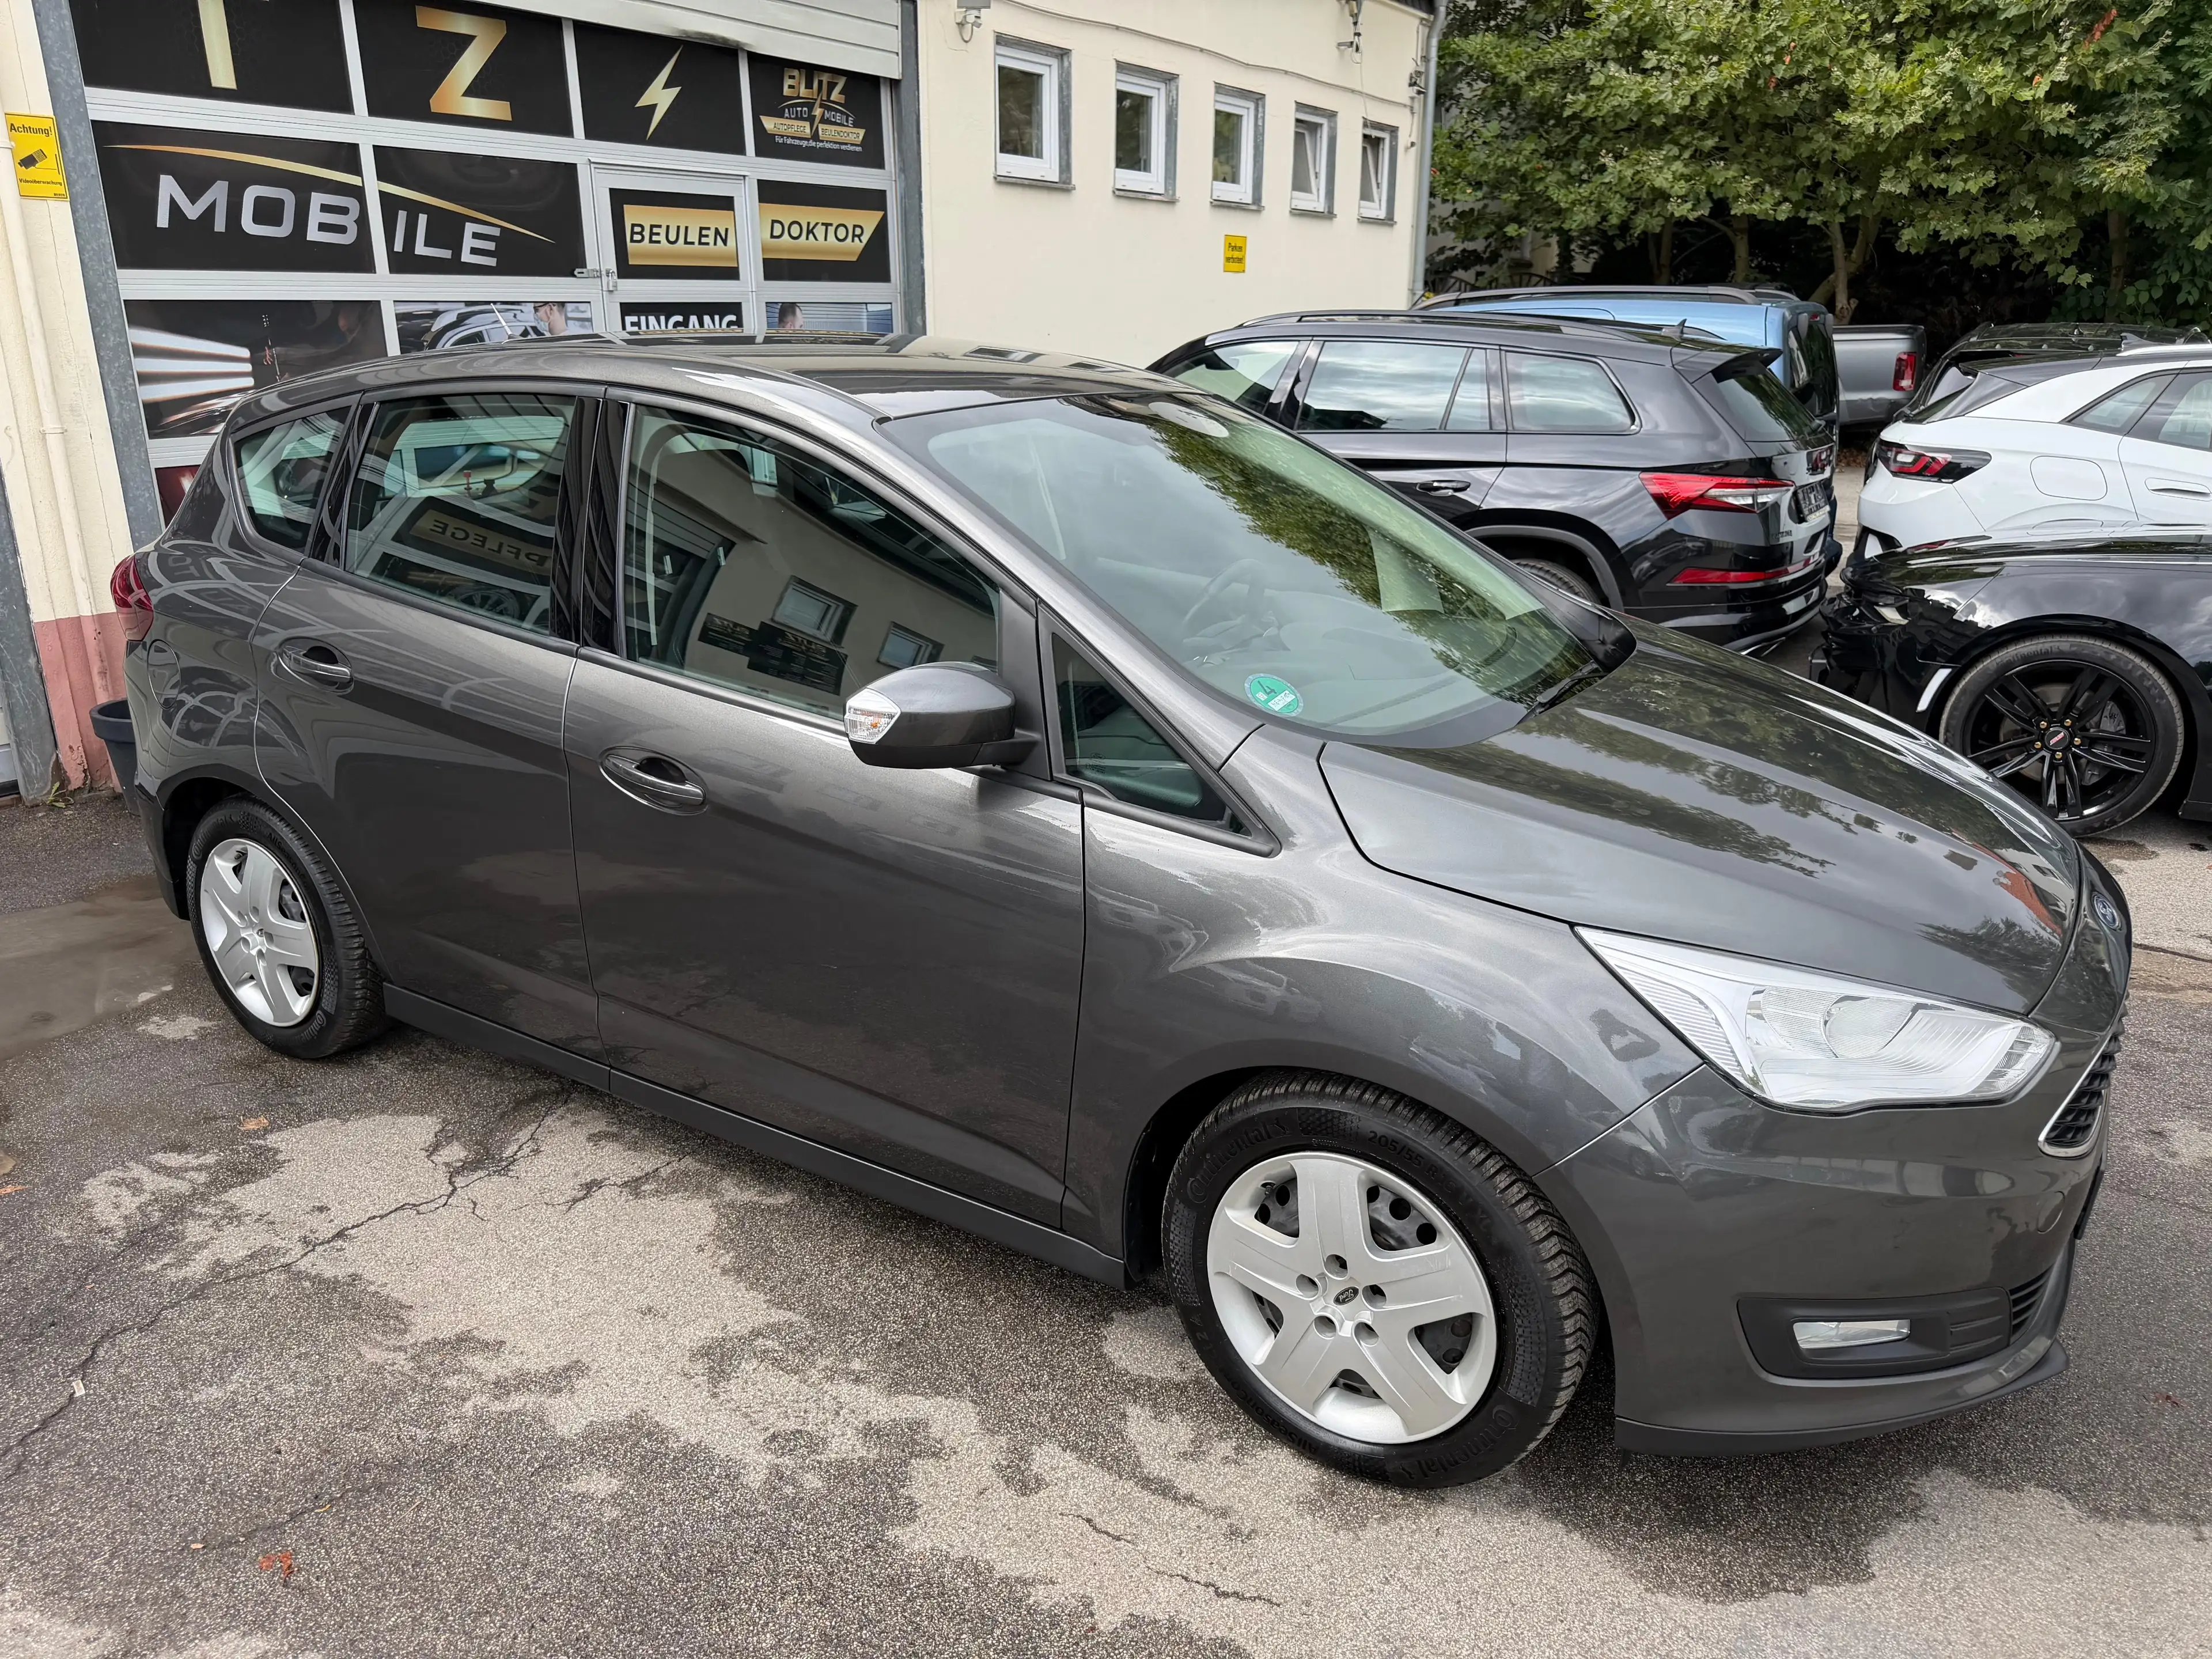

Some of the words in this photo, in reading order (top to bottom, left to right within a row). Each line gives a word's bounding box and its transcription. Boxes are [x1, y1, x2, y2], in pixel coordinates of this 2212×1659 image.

[416, 5, 512, 120] Z
[783, 67, 847, 103] BLITZ
[784, 108, 808, 118] AUTO
[824, 110, 854, 127] MOBILE
[10, 123, 52, 137] Achtung!
[773, 122, 806, 133] AUTOPFLEGE
[821, 128, 861, 139] BEULENDOKTOR
[19, 177, 63, 186] Videoüberwachung
[157, 175, 501, 267] MOBILE
[630, 223, 729, 247] BEULEN
[770, 219, 864, 243] DOKTOR
[1368, 1130, 1425, 1168] 205/55
[1338, 1289, 1354, 1302] Ford
